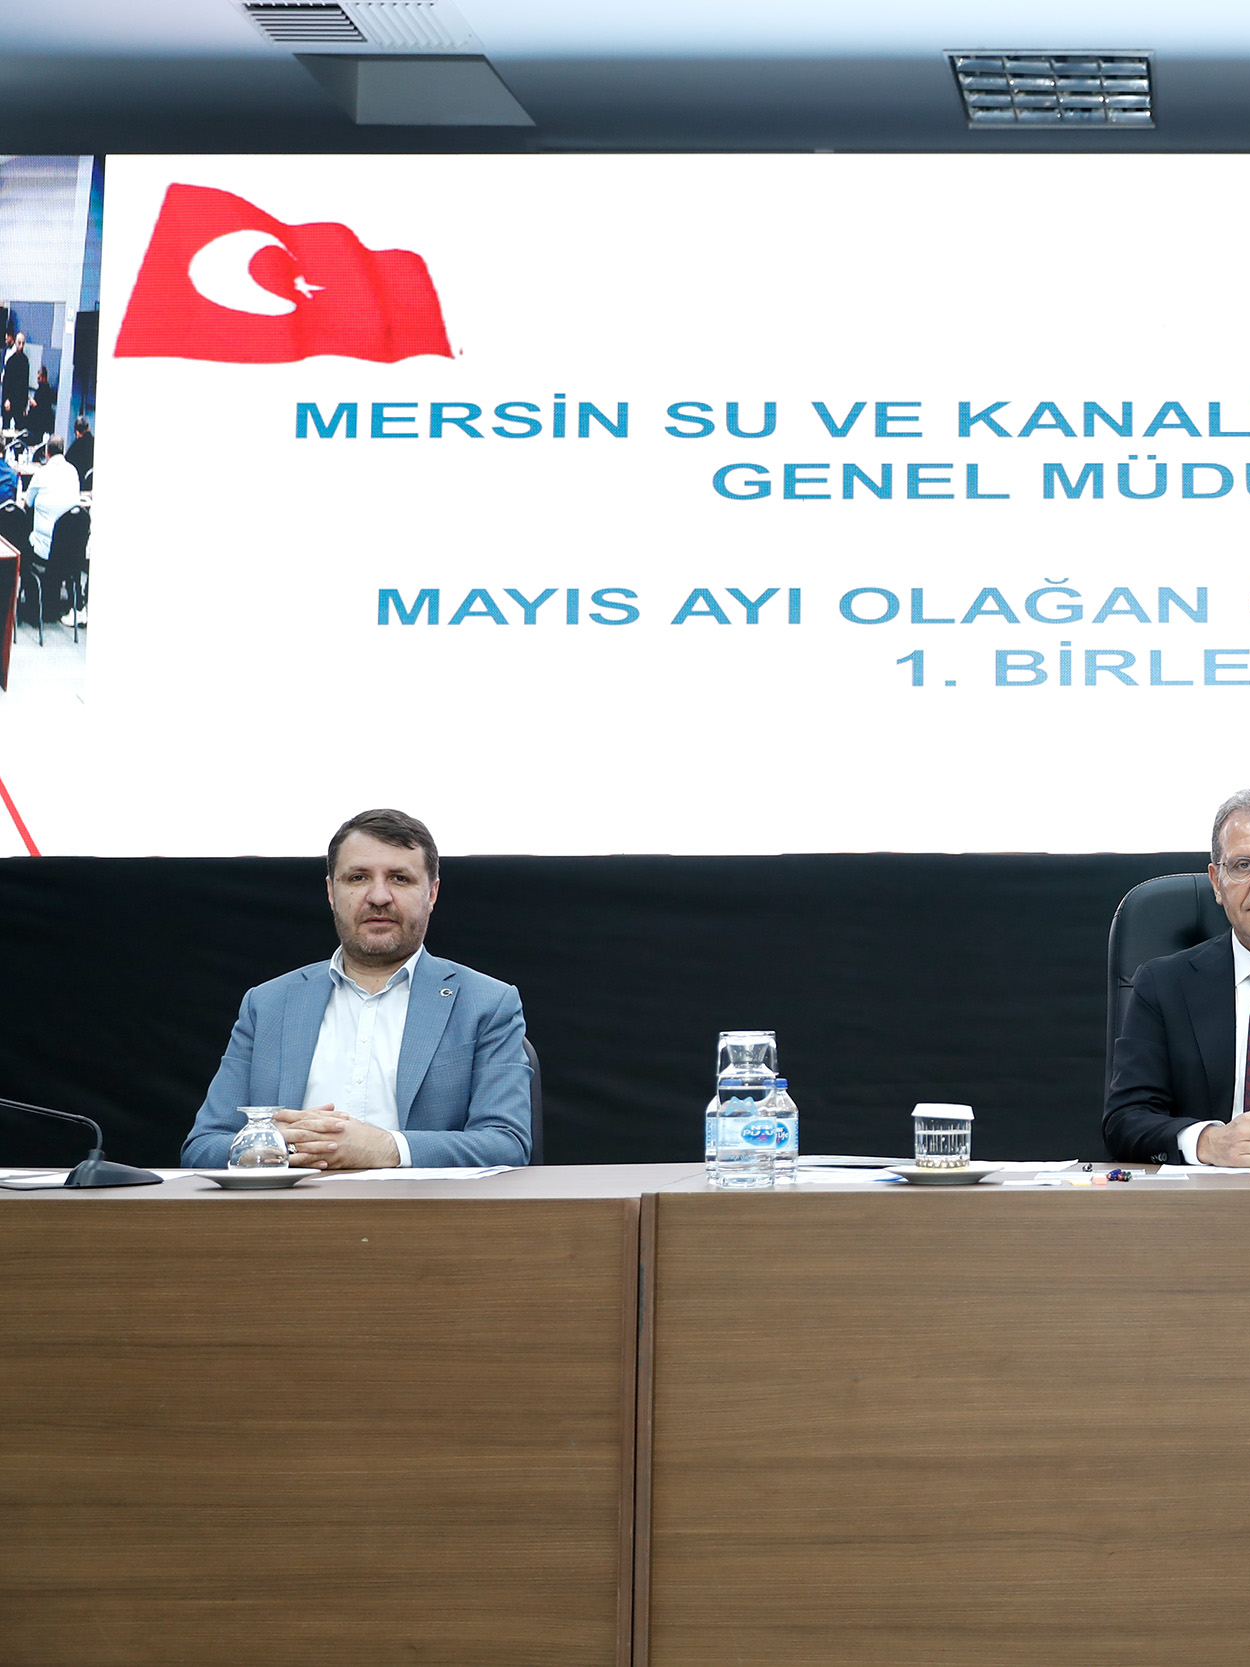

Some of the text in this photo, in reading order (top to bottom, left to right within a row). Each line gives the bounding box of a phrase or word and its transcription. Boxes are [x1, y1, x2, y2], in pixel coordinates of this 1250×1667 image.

[295, 392, 629, 439] MERSİN
[664, 400, 777, 438] SU
[811, 401, 924, 438] VE
[712, 462, 1011, 500] GENEL
[377, 587, 641, 626] MAYIS
[670, 587, 802, 625] AYI
[838, 577, 1208, 625] OLAĞAN
[896, 649, 957, 687] 1.
